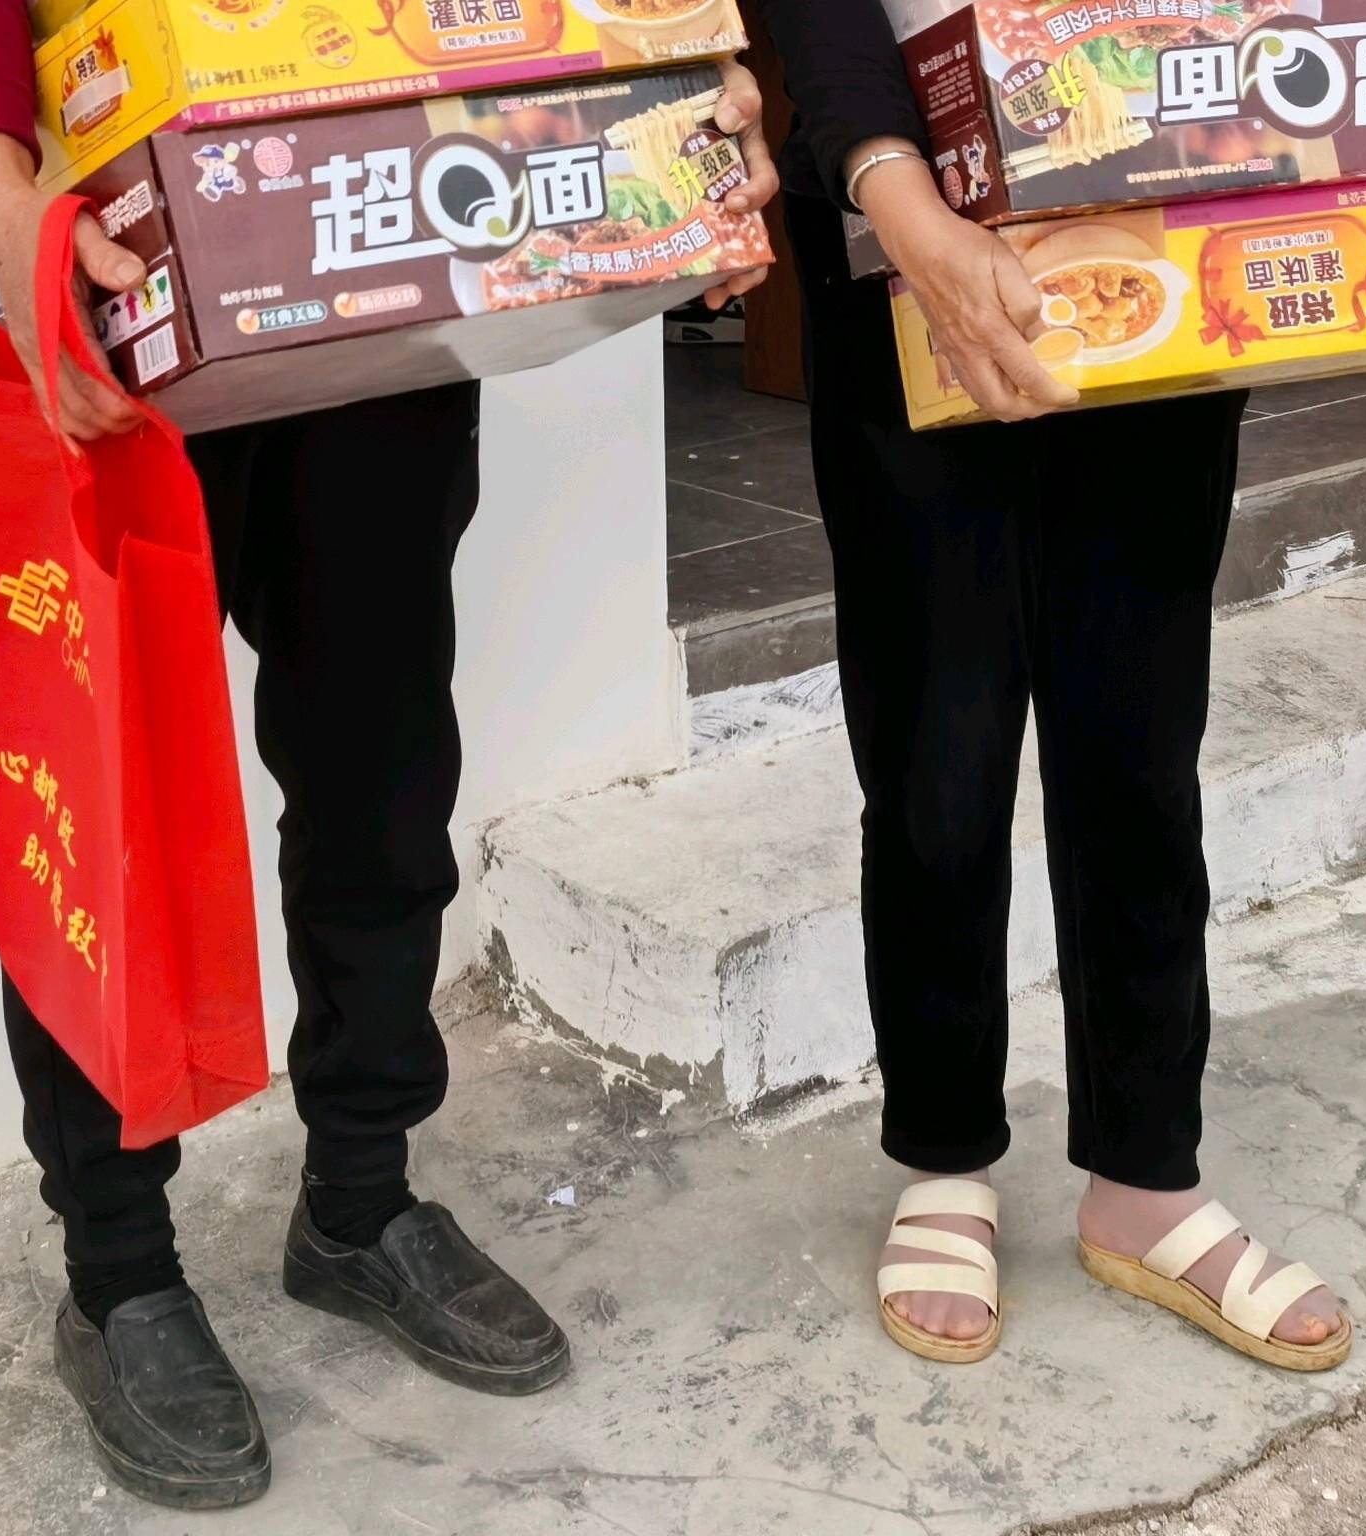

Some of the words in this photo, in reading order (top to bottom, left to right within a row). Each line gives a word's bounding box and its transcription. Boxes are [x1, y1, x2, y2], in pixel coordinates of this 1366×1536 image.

[569, 223, 713, 274] 香辣原汁牛肉面
[1246, 250, 1345, 292] 灌味面
[1266, 289, 1336, 330] 特级
